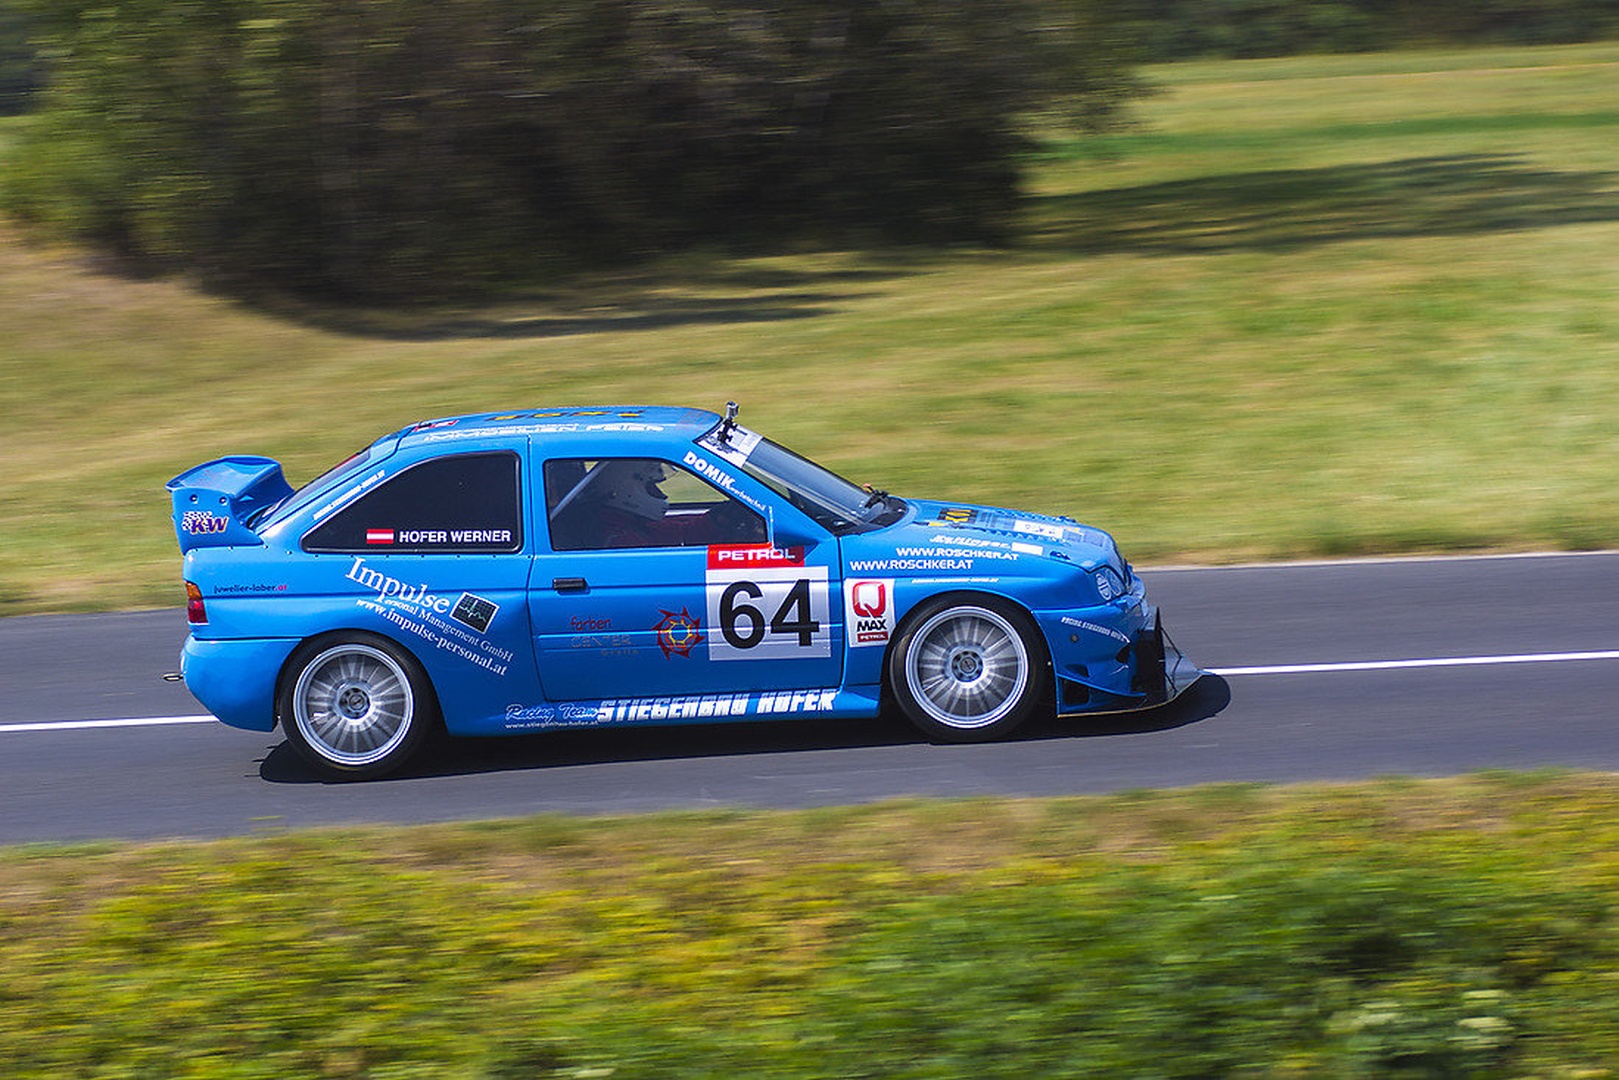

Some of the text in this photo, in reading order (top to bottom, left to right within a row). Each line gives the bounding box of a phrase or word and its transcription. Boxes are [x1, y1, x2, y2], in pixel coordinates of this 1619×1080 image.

[683, 451, 735, 489] DOMIK
[190, 516, 229, 535] KW
[399, 530, 511, 543] HOFER WERNER
[718, 548, 796, 561] PETROL
[849, 559, 974, 571] WWW.ROSCHKER.AT
[896, 547, 1019, 561] WWW.ROSCHKER.AT
[345, 556, 451, 614] Impulse
[852, 581, 886, 618] Q
[719, 579, 820, 649] 64
[857, 619, 887, 632] MAX
[355, 598, 508, 676] www.impulse-personal.at
[419, 608, 479, 646] Management
[479, 640, 514, 662] GmbH
[505, 703, 555, 723] Racing
[757, 689, 839, 714] HOFER
